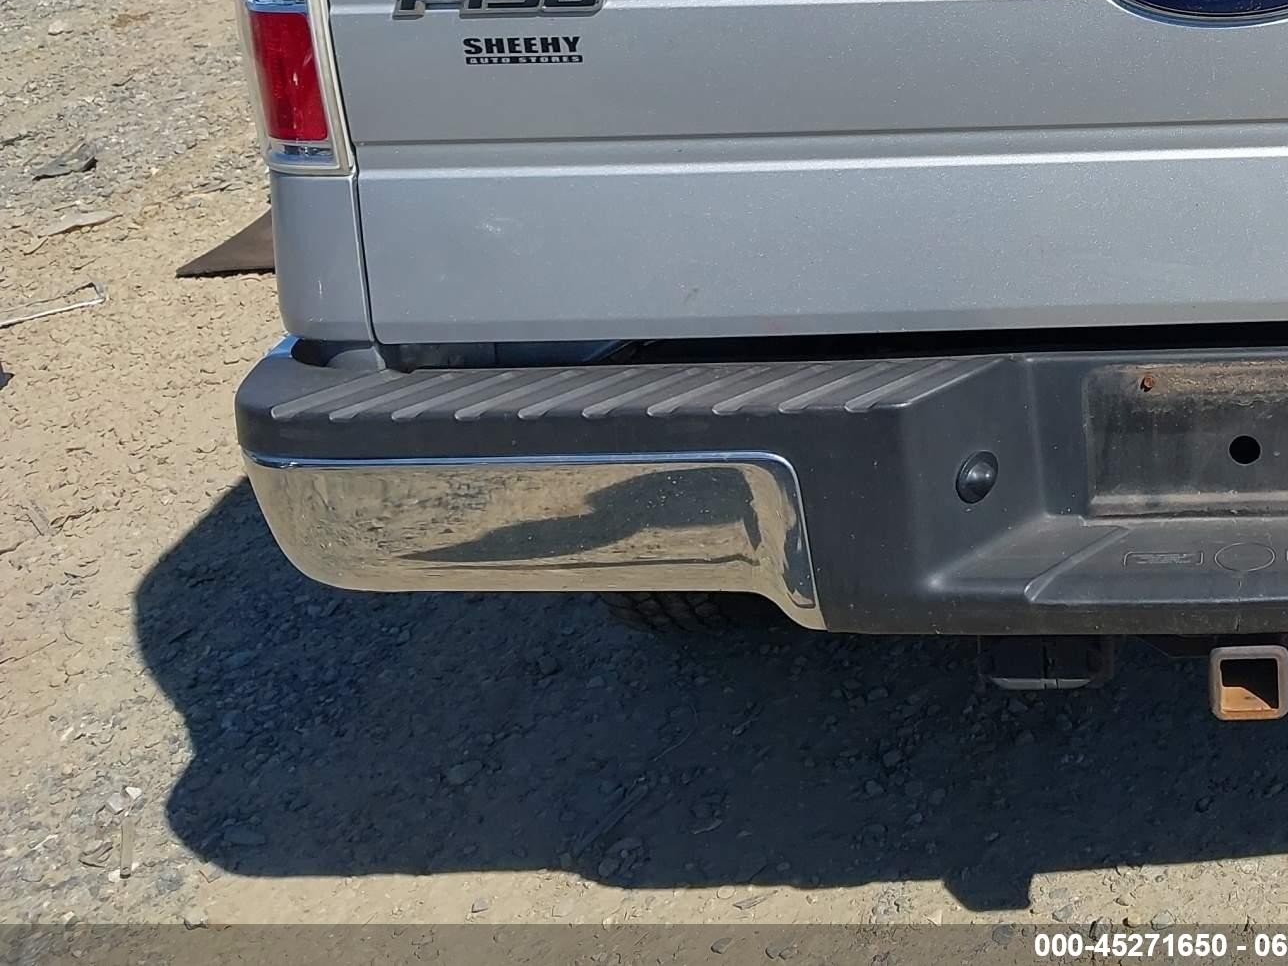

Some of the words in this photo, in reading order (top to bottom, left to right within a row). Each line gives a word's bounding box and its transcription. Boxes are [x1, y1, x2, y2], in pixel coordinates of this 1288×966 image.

[463, 36, 581, 55] SHEEHY
[468, 56, 512, 64] AUTO
[518, 55, 582, 63] STORES
